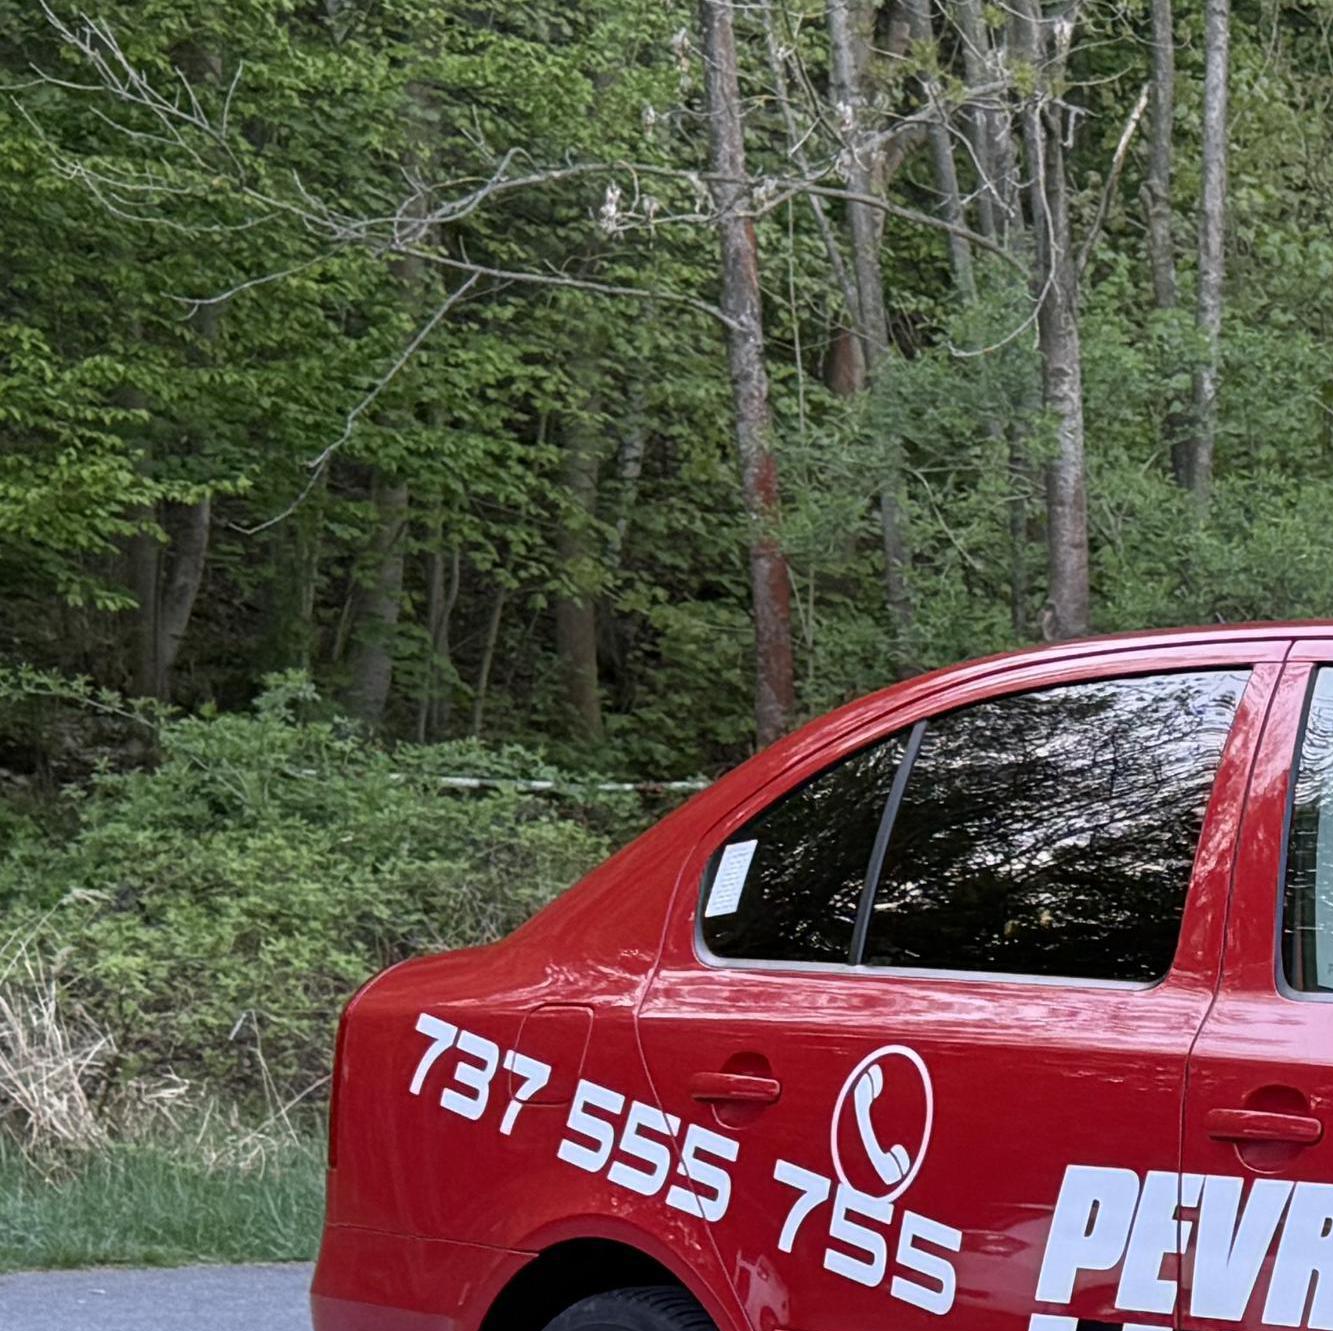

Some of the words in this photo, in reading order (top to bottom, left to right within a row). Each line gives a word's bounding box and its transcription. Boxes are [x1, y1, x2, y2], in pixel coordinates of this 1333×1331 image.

[409, 1012, 552, 1135] 737
[557, 1079, 740, 1222] 555
[773, 1159, 962, 1315] 755
